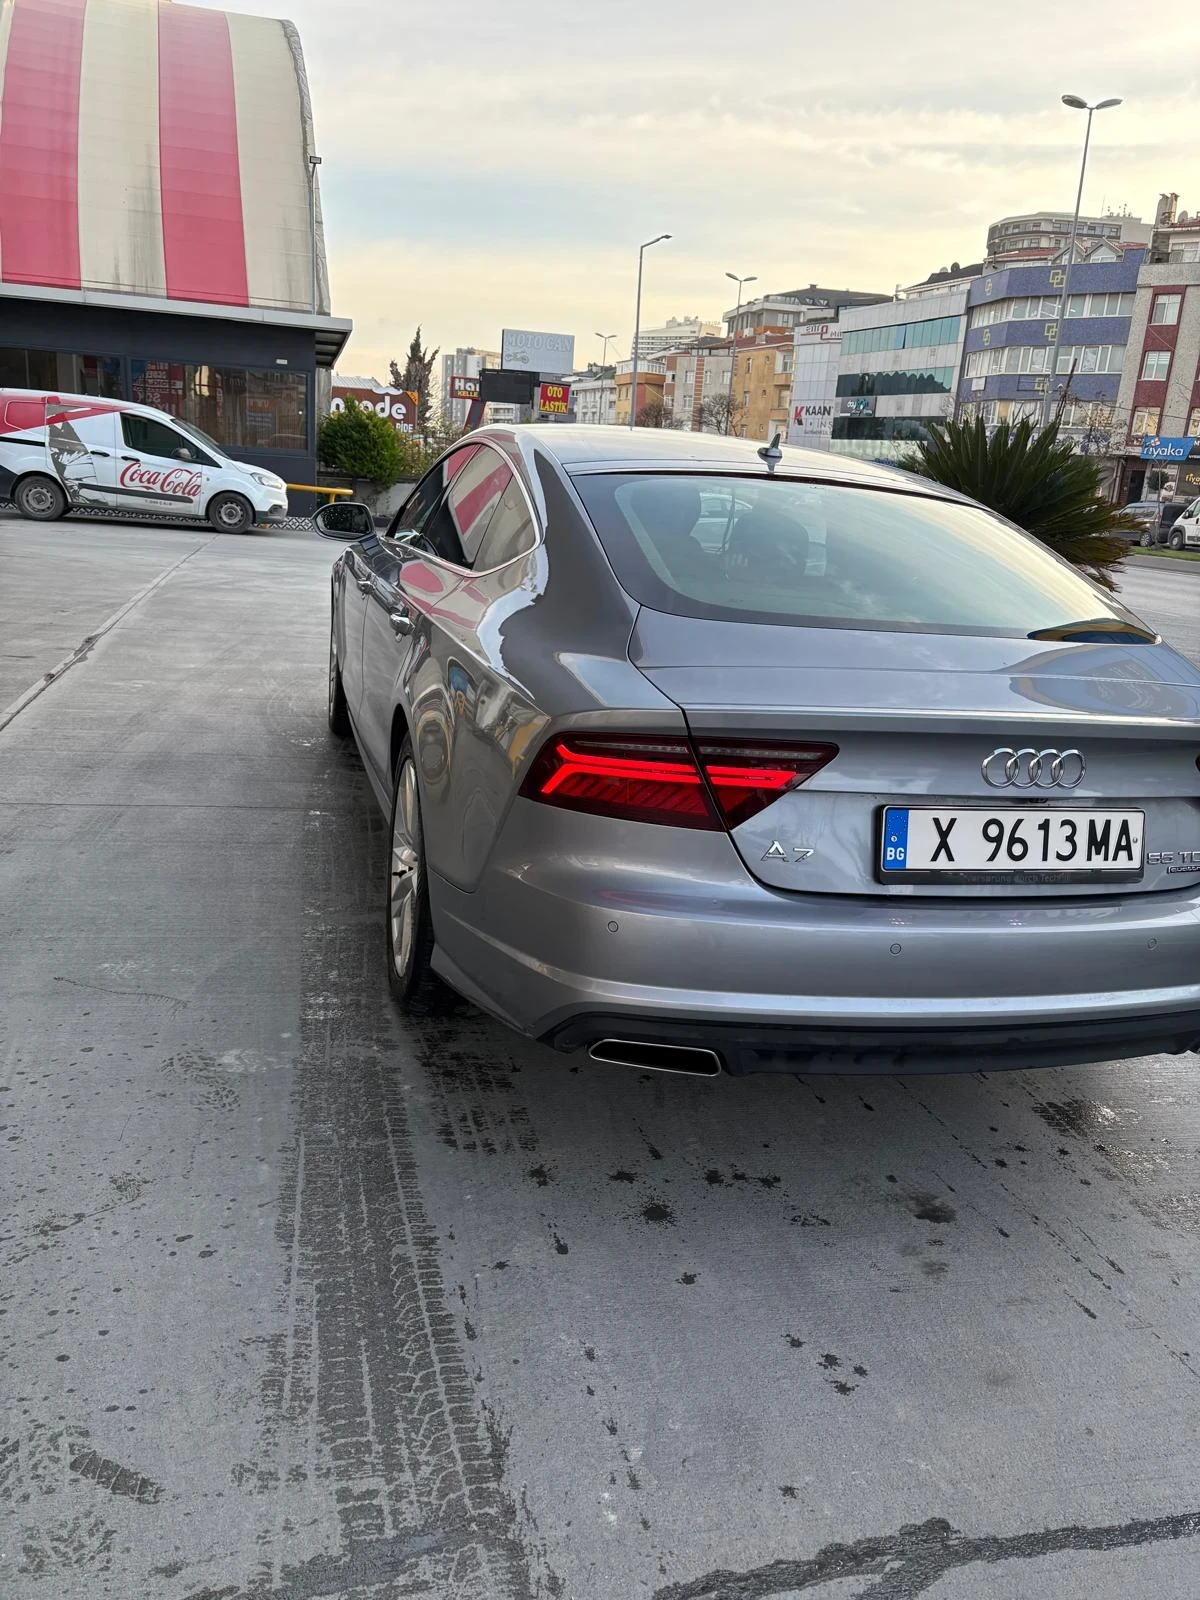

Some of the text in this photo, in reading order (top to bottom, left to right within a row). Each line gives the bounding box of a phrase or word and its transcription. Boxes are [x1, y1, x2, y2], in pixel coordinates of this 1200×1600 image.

[547, 386, 563, 398] OTO
[540, 399, 567, 413] LASTİK
[805, 405, 831, 416] KAAN
[120, 462, 202, 497] Coca-Cola
[930, 817, 1134, 862] X 9613 MA
[886, 847, 905, 860] BG
[1147, 852, 1174, 865] 55
